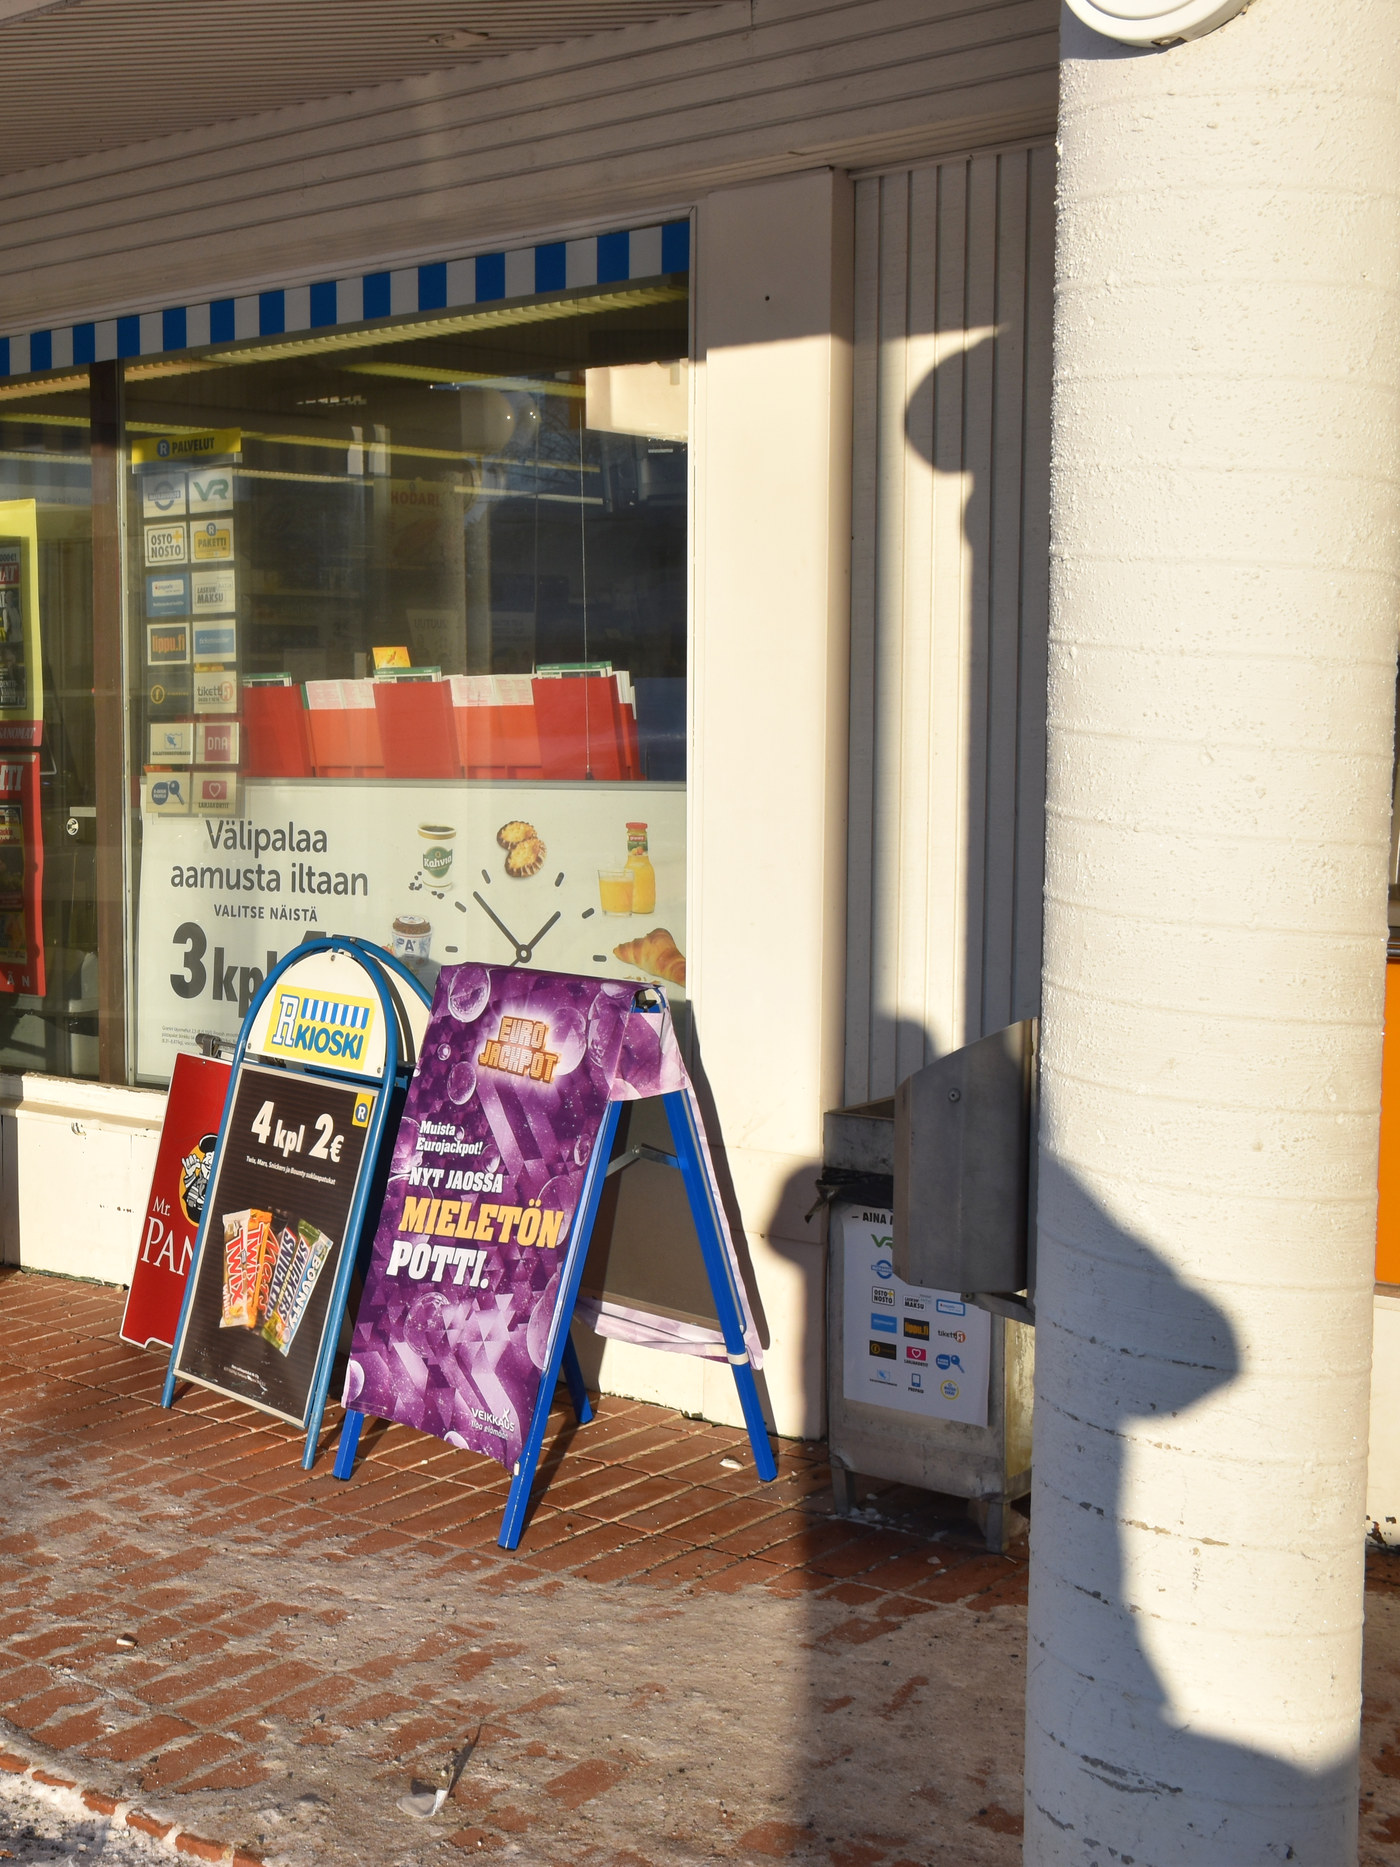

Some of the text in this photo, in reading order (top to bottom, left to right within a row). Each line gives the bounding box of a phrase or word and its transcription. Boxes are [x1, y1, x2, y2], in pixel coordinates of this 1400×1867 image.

[172, 437, 215, 454] PALVELUT
[193, 478, 229, 501] VR
[151, 533, 172, 545] OSTO
[197, 537, 227, 548] PAKETTI
[151, 545, 181, 558] NOSTO
[197, 593, 224, 604] MAKSU
[207, 736, 228, 750] DNA
[205, 819, 328, 859] Välipalaa
[171, 862, 368, 896] aamusta iltaan
[213, 903, 318, 922] VALITSE NÄISTÄ
[170, 921, 207, 999] 3
[271, 993, 300, 1048] R
[294, 1023, 364, 1061] KIOSKI
[498, 1016, 547, 1051] EURO
[478, 1040, 559, 1084] JACKPOT
[357, 1105, 367, 1120] R
[251, 1100, 275, 1144] 4
[273, 1119, 306, 1158] kpl
[418, 1120, 456, 1136] Muista
[415, 1137, 483, 1157] Eurojackpot!
[408, 1167, 503, 1193] NYT JAOSSA
[152, 1195, 171, 1216] Mr.
[398, 1195, 565, 1249] MIELETÖN
[862, 1211, 888, 1225] AINA
[226, 1227, 244, 1307] TWIX
[386, 1239, 489, 1290] POTTI.
[288, 1254, 321, 1330] BOUNTY
[873, 1289, 888, 1297] OSTO
[873, 1294, 893, 1304] NOSTO
[904, 1300, 925, 1310] MAKSU
[471, 1407, 515, 1433] VEIKKAUS
